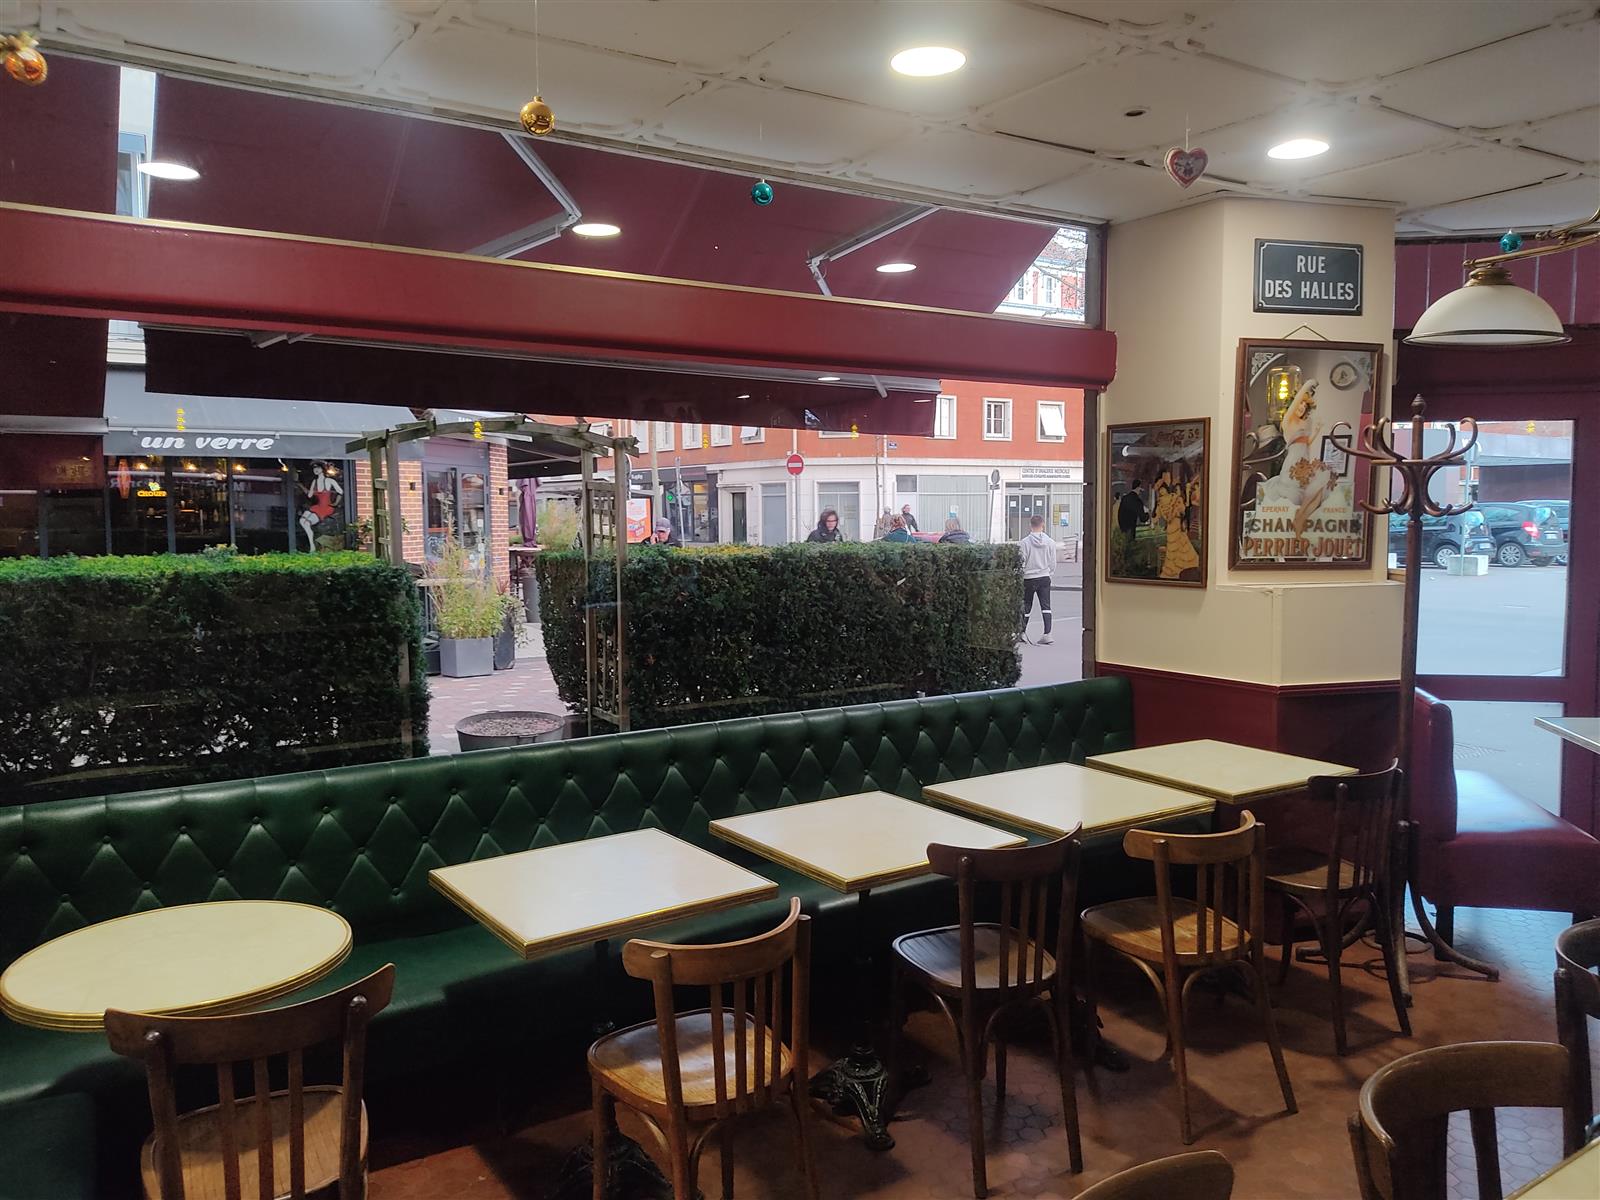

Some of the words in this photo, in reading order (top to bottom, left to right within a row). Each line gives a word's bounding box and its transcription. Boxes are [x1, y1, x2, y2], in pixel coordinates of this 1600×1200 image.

[1297, 255, 1326, 273] RUE
[1265, 280, 1292, 298] DES
[1301, 281, 1354, 300] HALLES
[140, 436, 186, 449] un
[195, 436, 275, 450] verre
